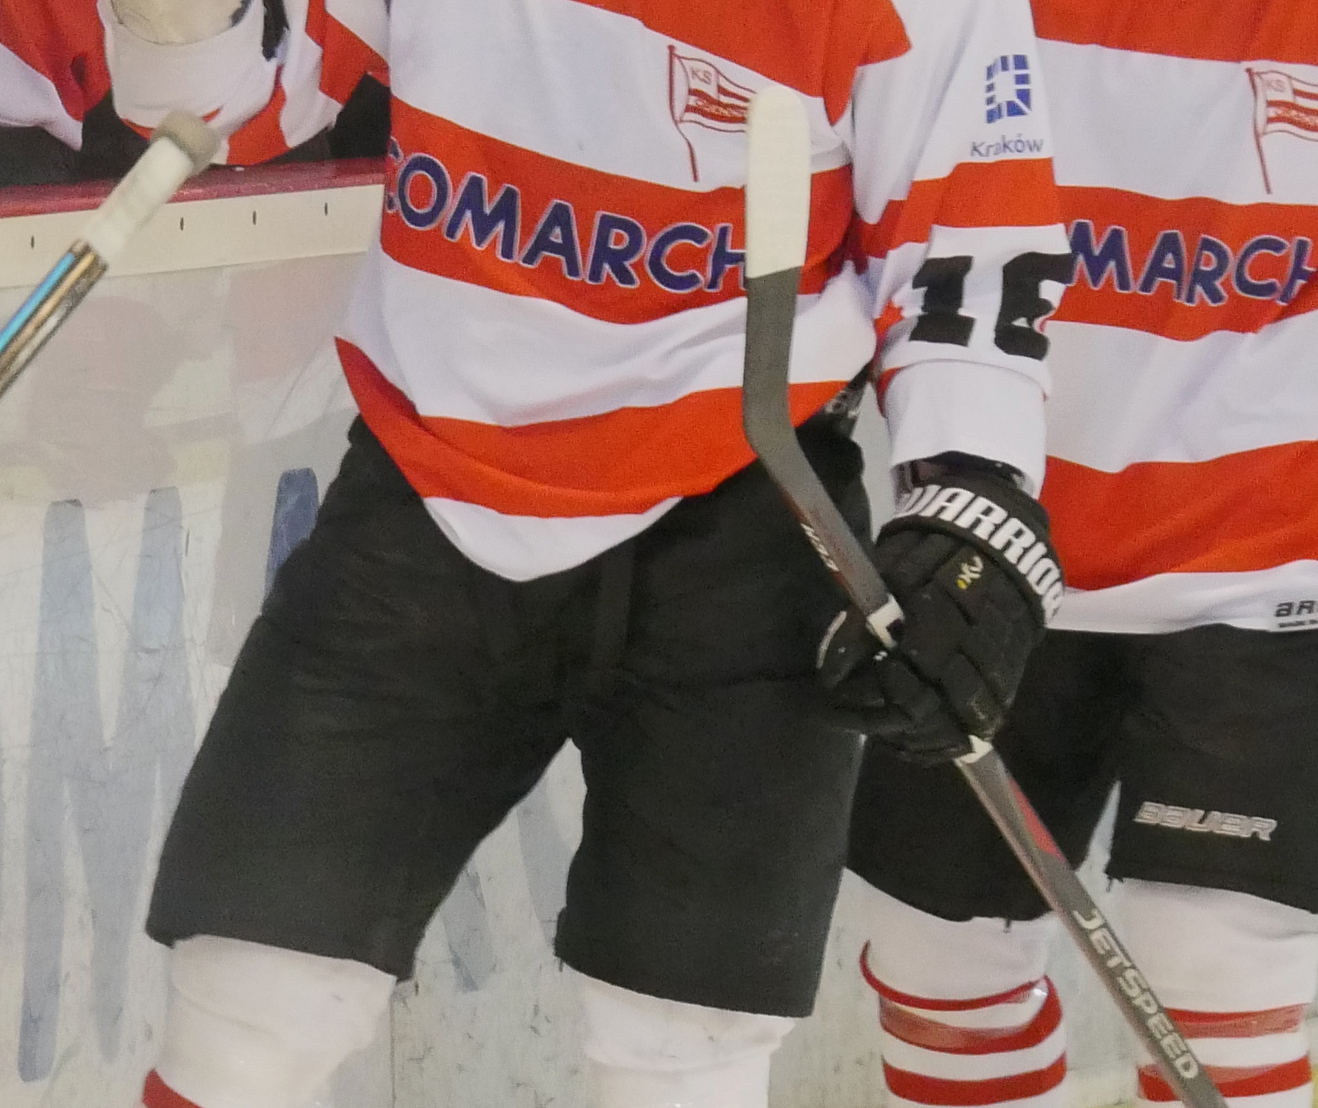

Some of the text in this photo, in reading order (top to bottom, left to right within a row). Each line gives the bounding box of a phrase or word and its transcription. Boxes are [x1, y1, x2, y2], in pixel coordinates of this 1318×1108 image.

[969, 132, 1045, 158] Kraków
[385, 137, 748, 294] OMARCH
[1133, 801, 1278, 841] BAUER
[1072, 908, 1200, 1080] JETSPEED
